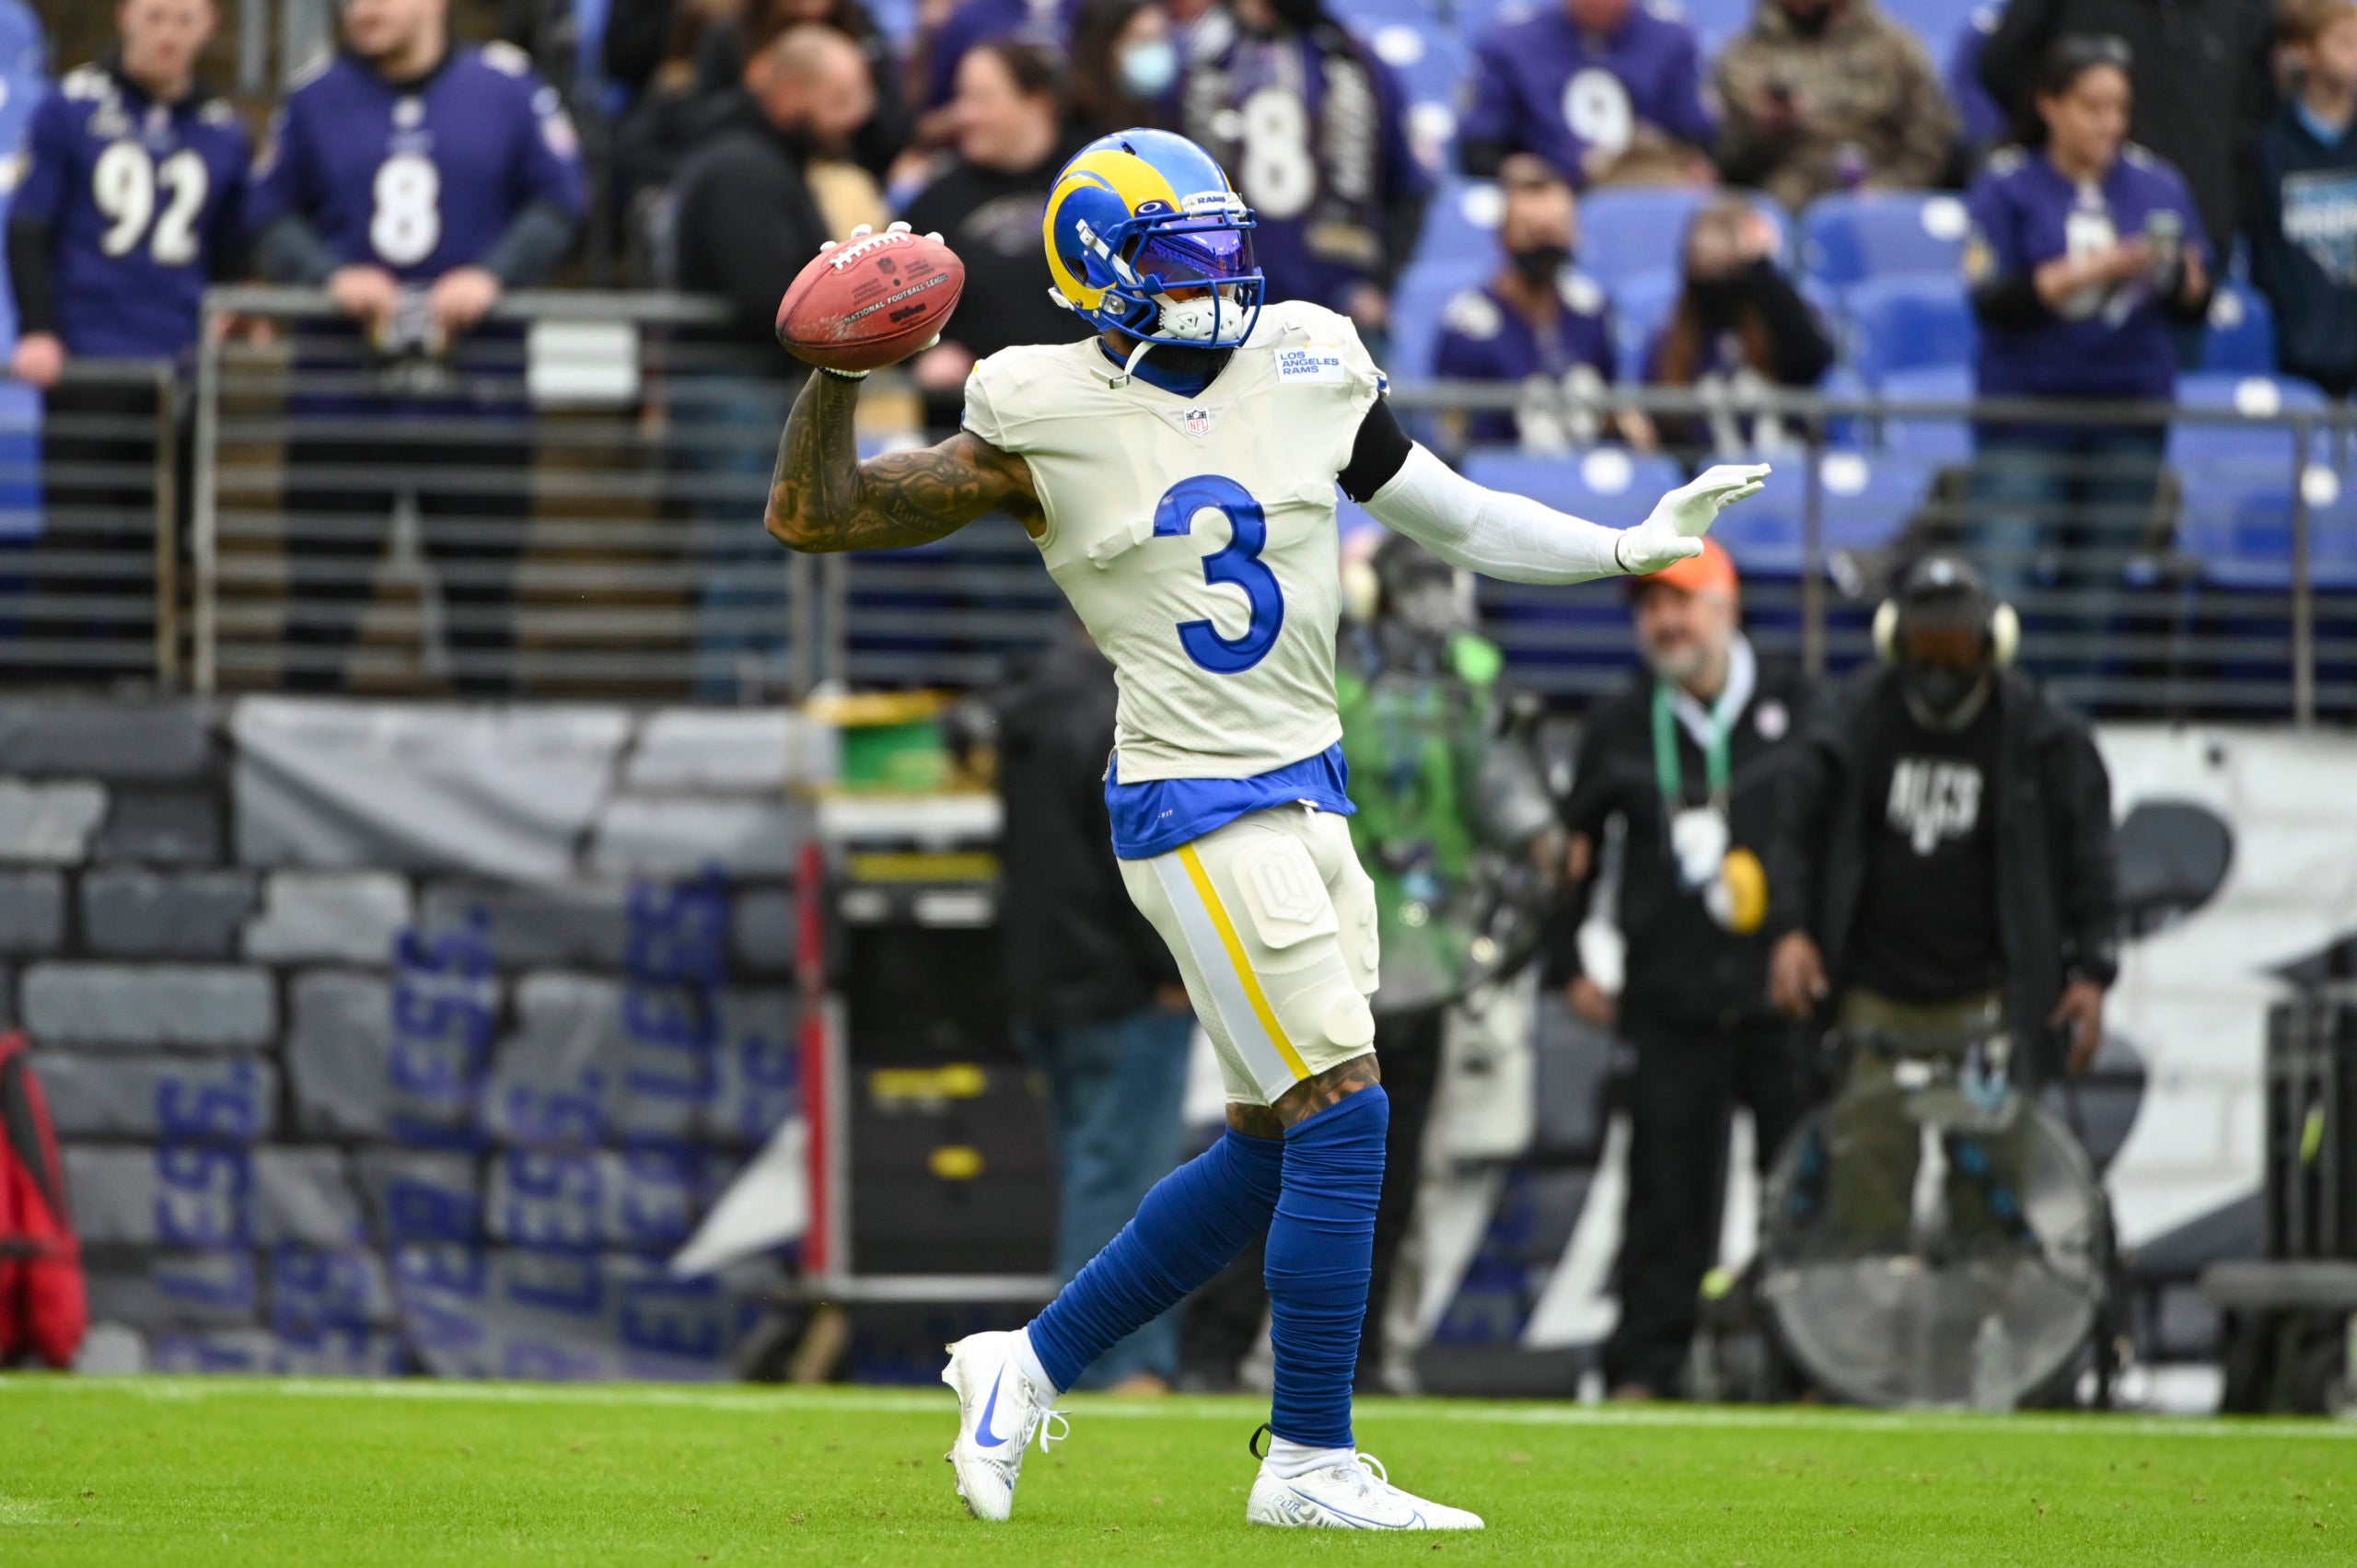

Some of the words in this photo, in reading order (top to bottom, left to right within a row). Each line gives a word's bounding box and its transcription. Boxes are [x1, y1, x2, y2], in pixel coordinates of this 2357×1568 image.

[1243, 88, 1316, 218] 8
[94, 140, 208, 265] 92
[370, 156, 439, 265] 8
[843, 300, 886, 324] NATIONAL
[887, 283, 925, 305] FOOTBALL
[1280, 351, 1306, 360] LOS
[1282, 357, 1340, 367] ANGELES
[1283, 366, 1319, 376] RAMS
[1190, 419, 1207, 432] NFL
[1153, 474, 1284, 675] 3
